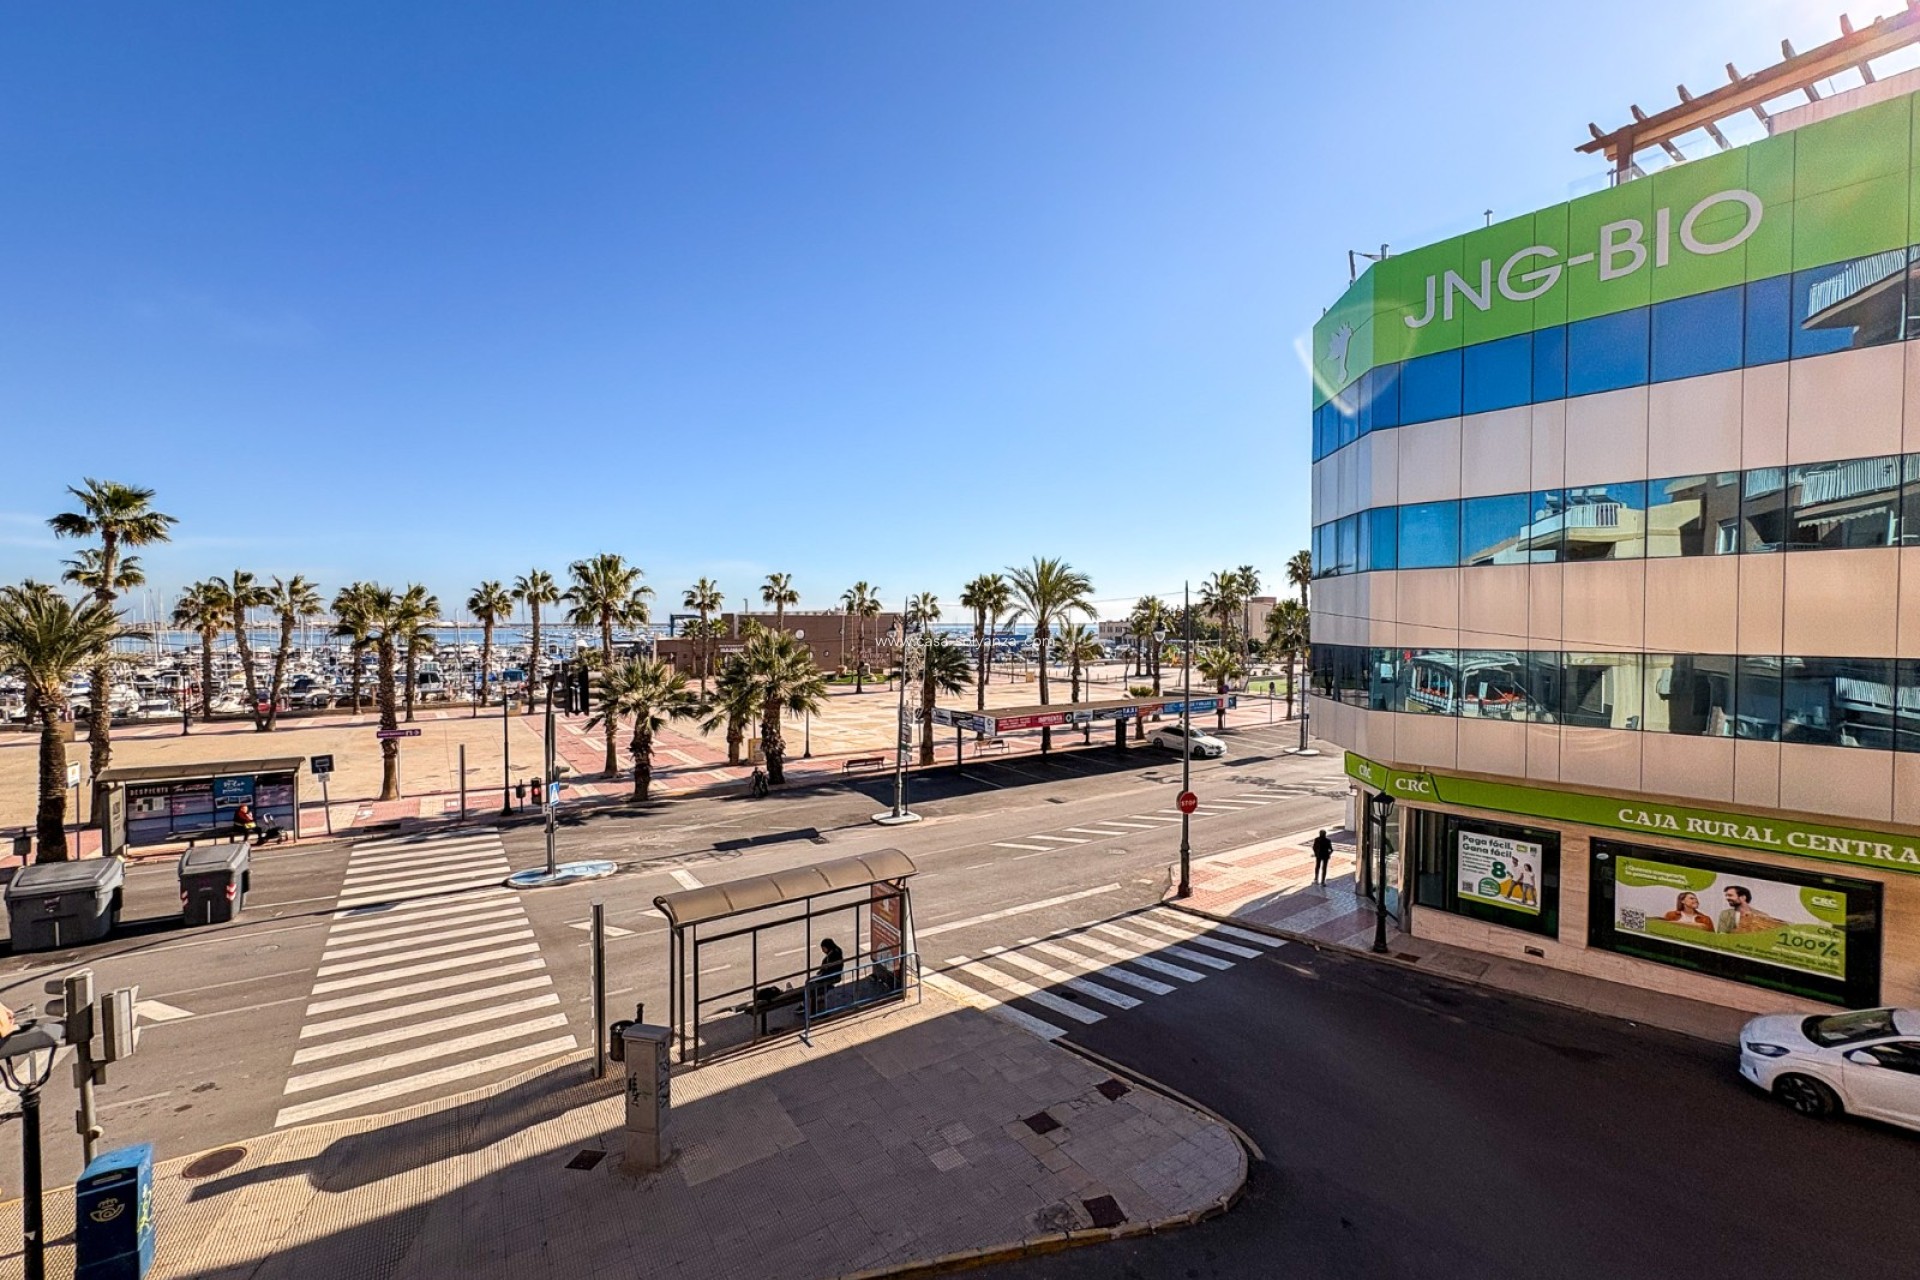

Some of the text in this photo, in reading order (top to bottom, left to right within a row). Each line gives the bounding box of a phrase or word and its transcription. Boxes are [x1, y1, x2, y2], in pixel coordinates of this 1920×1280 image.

[1403, 189, 1764, 329] JNG-BIO
[1395, 778, 1430, 794] CRC
[1618, 808, 1680, 830] CAJA
[1686, 817, 1781, 845] RURAL
[1462, 834, 1487, 846] Paga
[1462, 843, 1489, 854] Gana
[1776, 932, 1840, 957] 100%
